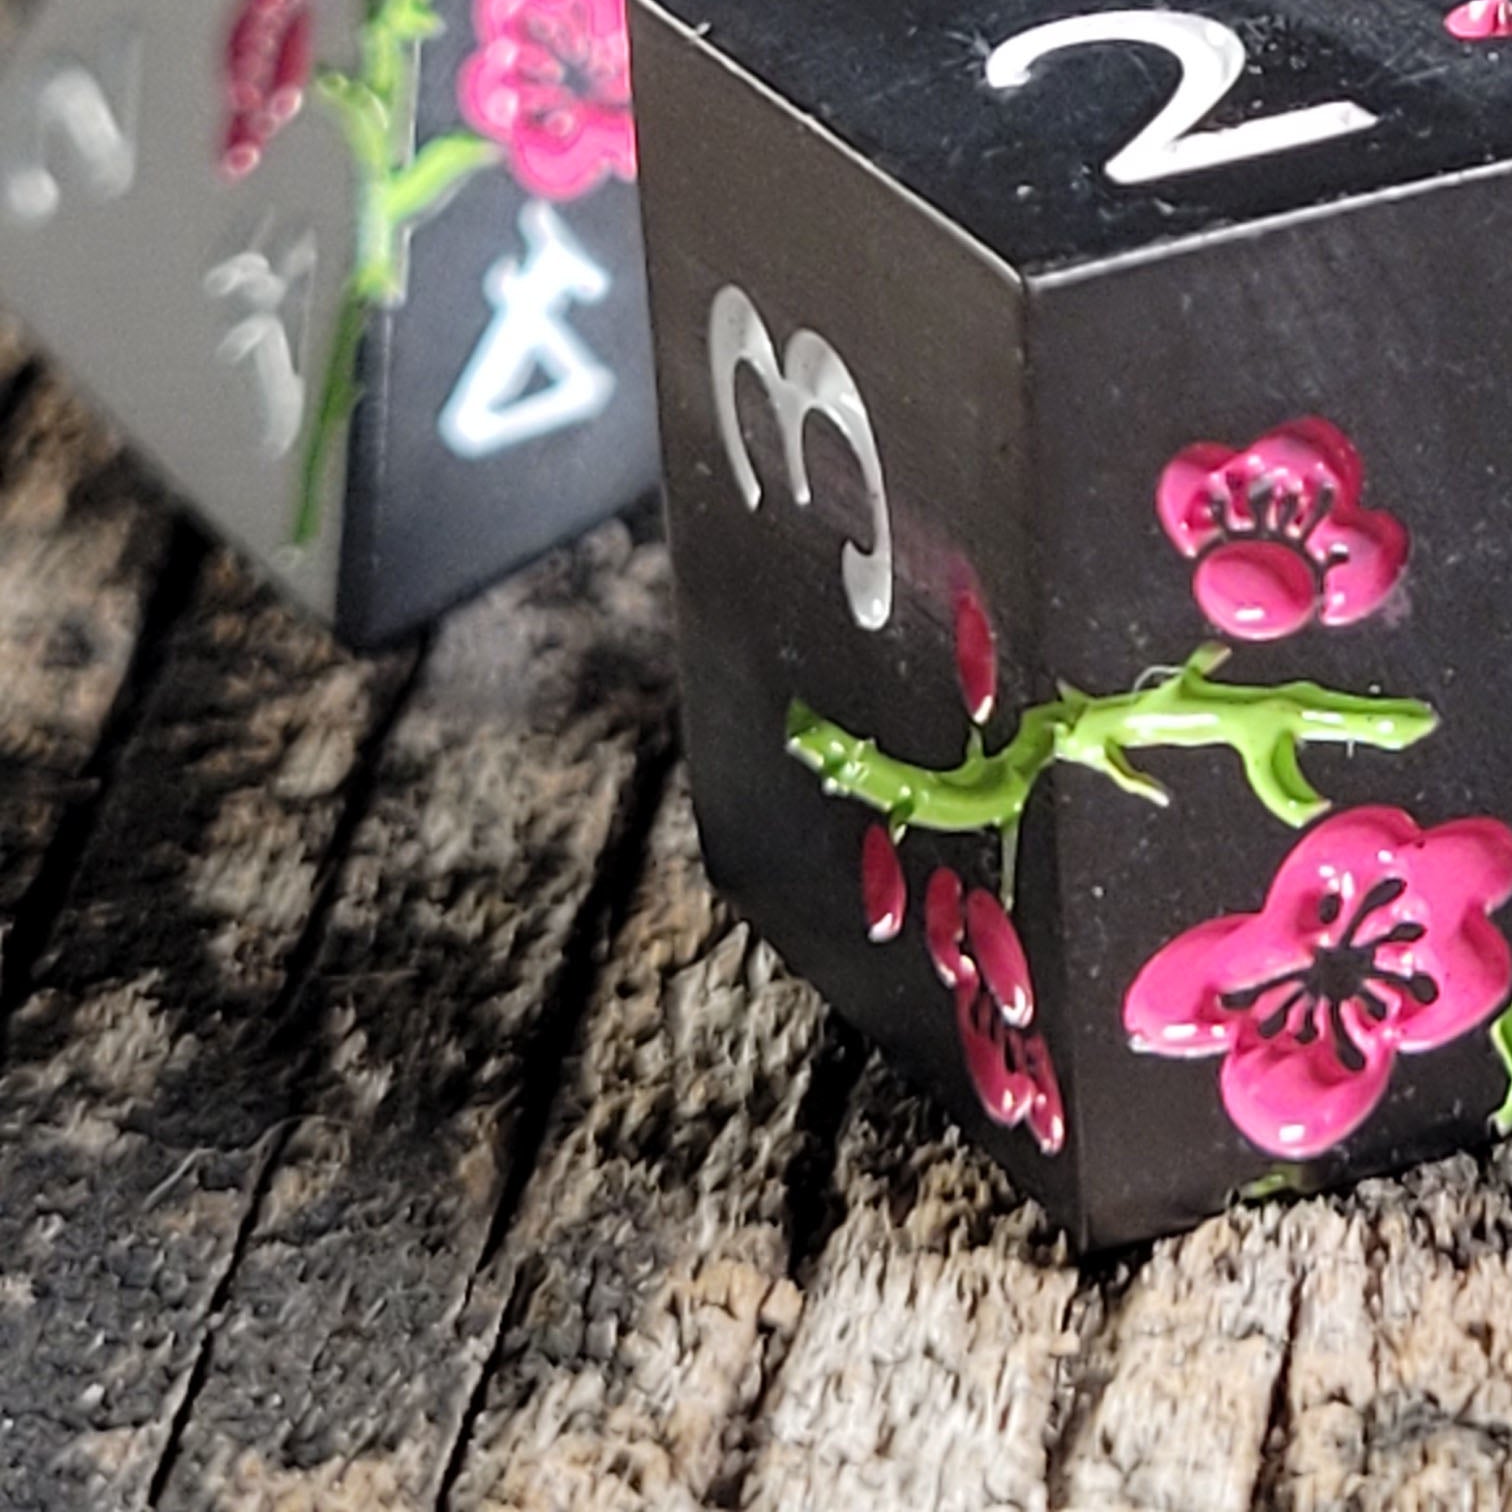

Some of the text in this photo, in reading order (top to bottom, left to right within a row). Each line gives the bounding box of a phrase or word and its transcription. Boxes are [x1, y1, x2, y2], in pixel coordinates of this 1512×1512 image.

[988, 10, 1379, 183] 2
[439, 200, 618, 456] 4
[709, 285, 893, 630] 3
